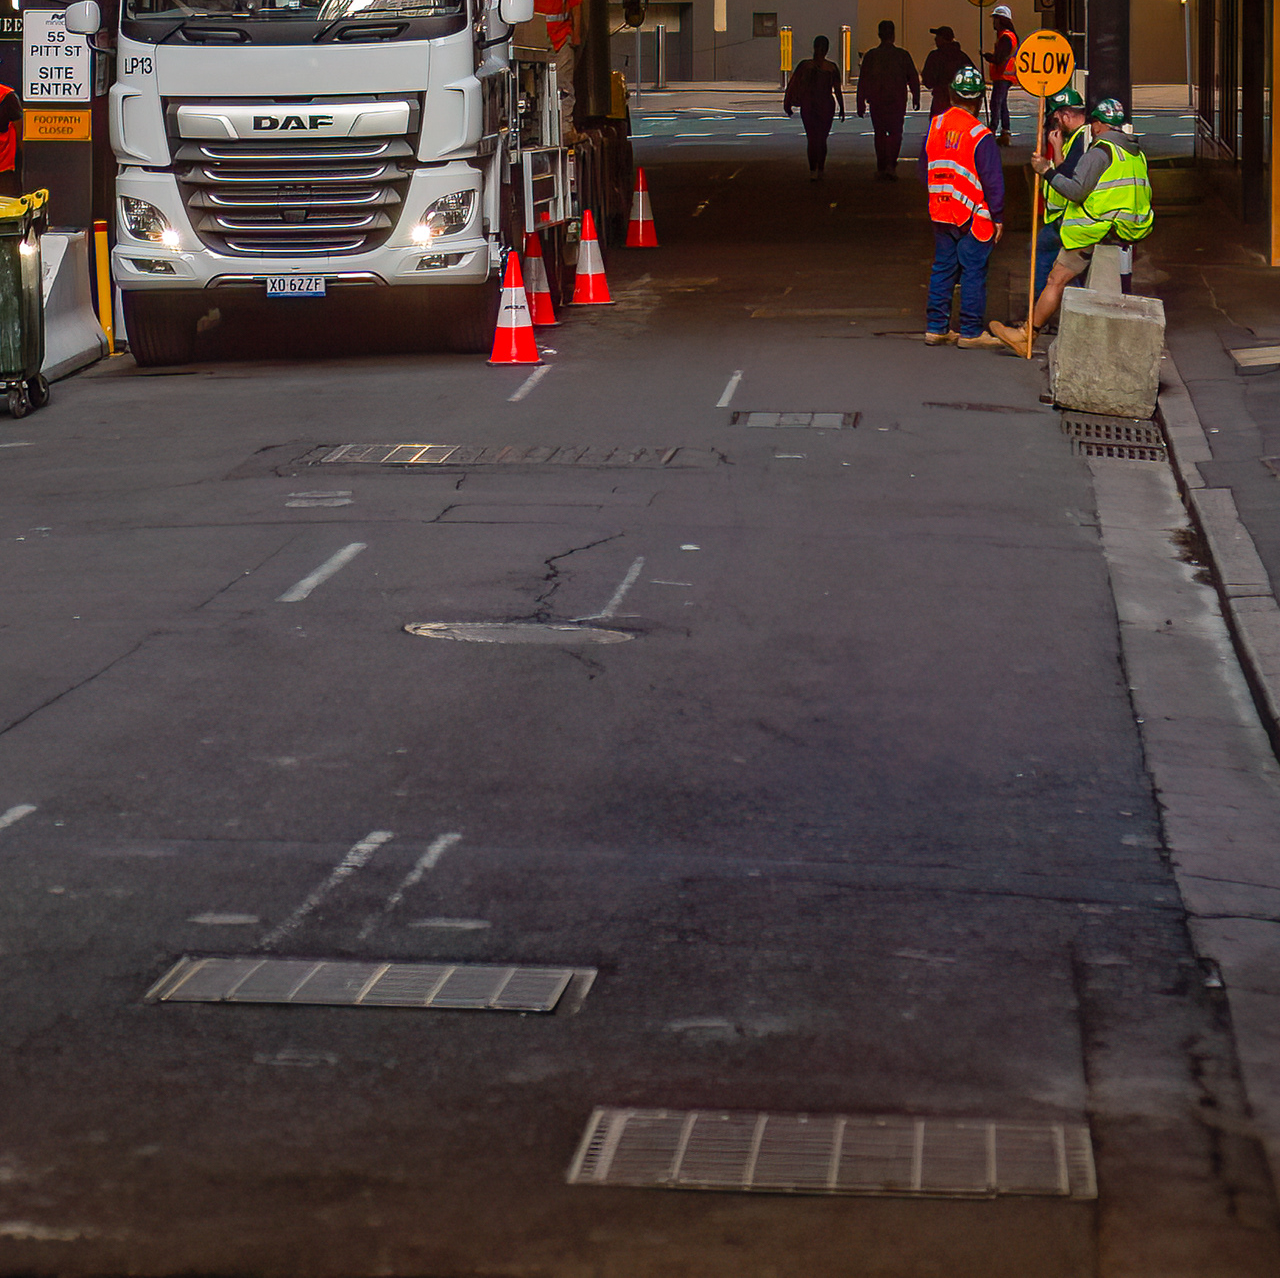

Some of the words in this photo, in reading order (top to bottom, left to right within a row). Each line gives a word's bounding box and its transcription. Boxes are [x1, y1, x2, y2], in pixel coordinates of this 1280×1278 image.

[47, 31, 66, 43] 55
[31, 45, 61, 56] PITT
[64, 45, 82, 56] ST
[124, 57, 153, 75] LP13
[1018, 52, 1071, 75] SLOW
[38, 67, 74, 80] SITE
[30, 83, 83, 96] ENTRY
[33, 116, 81, 124] FOOTPATH
[252, 115, 334, 130] DAF
[38, 127, 74, 135] CLOSED
